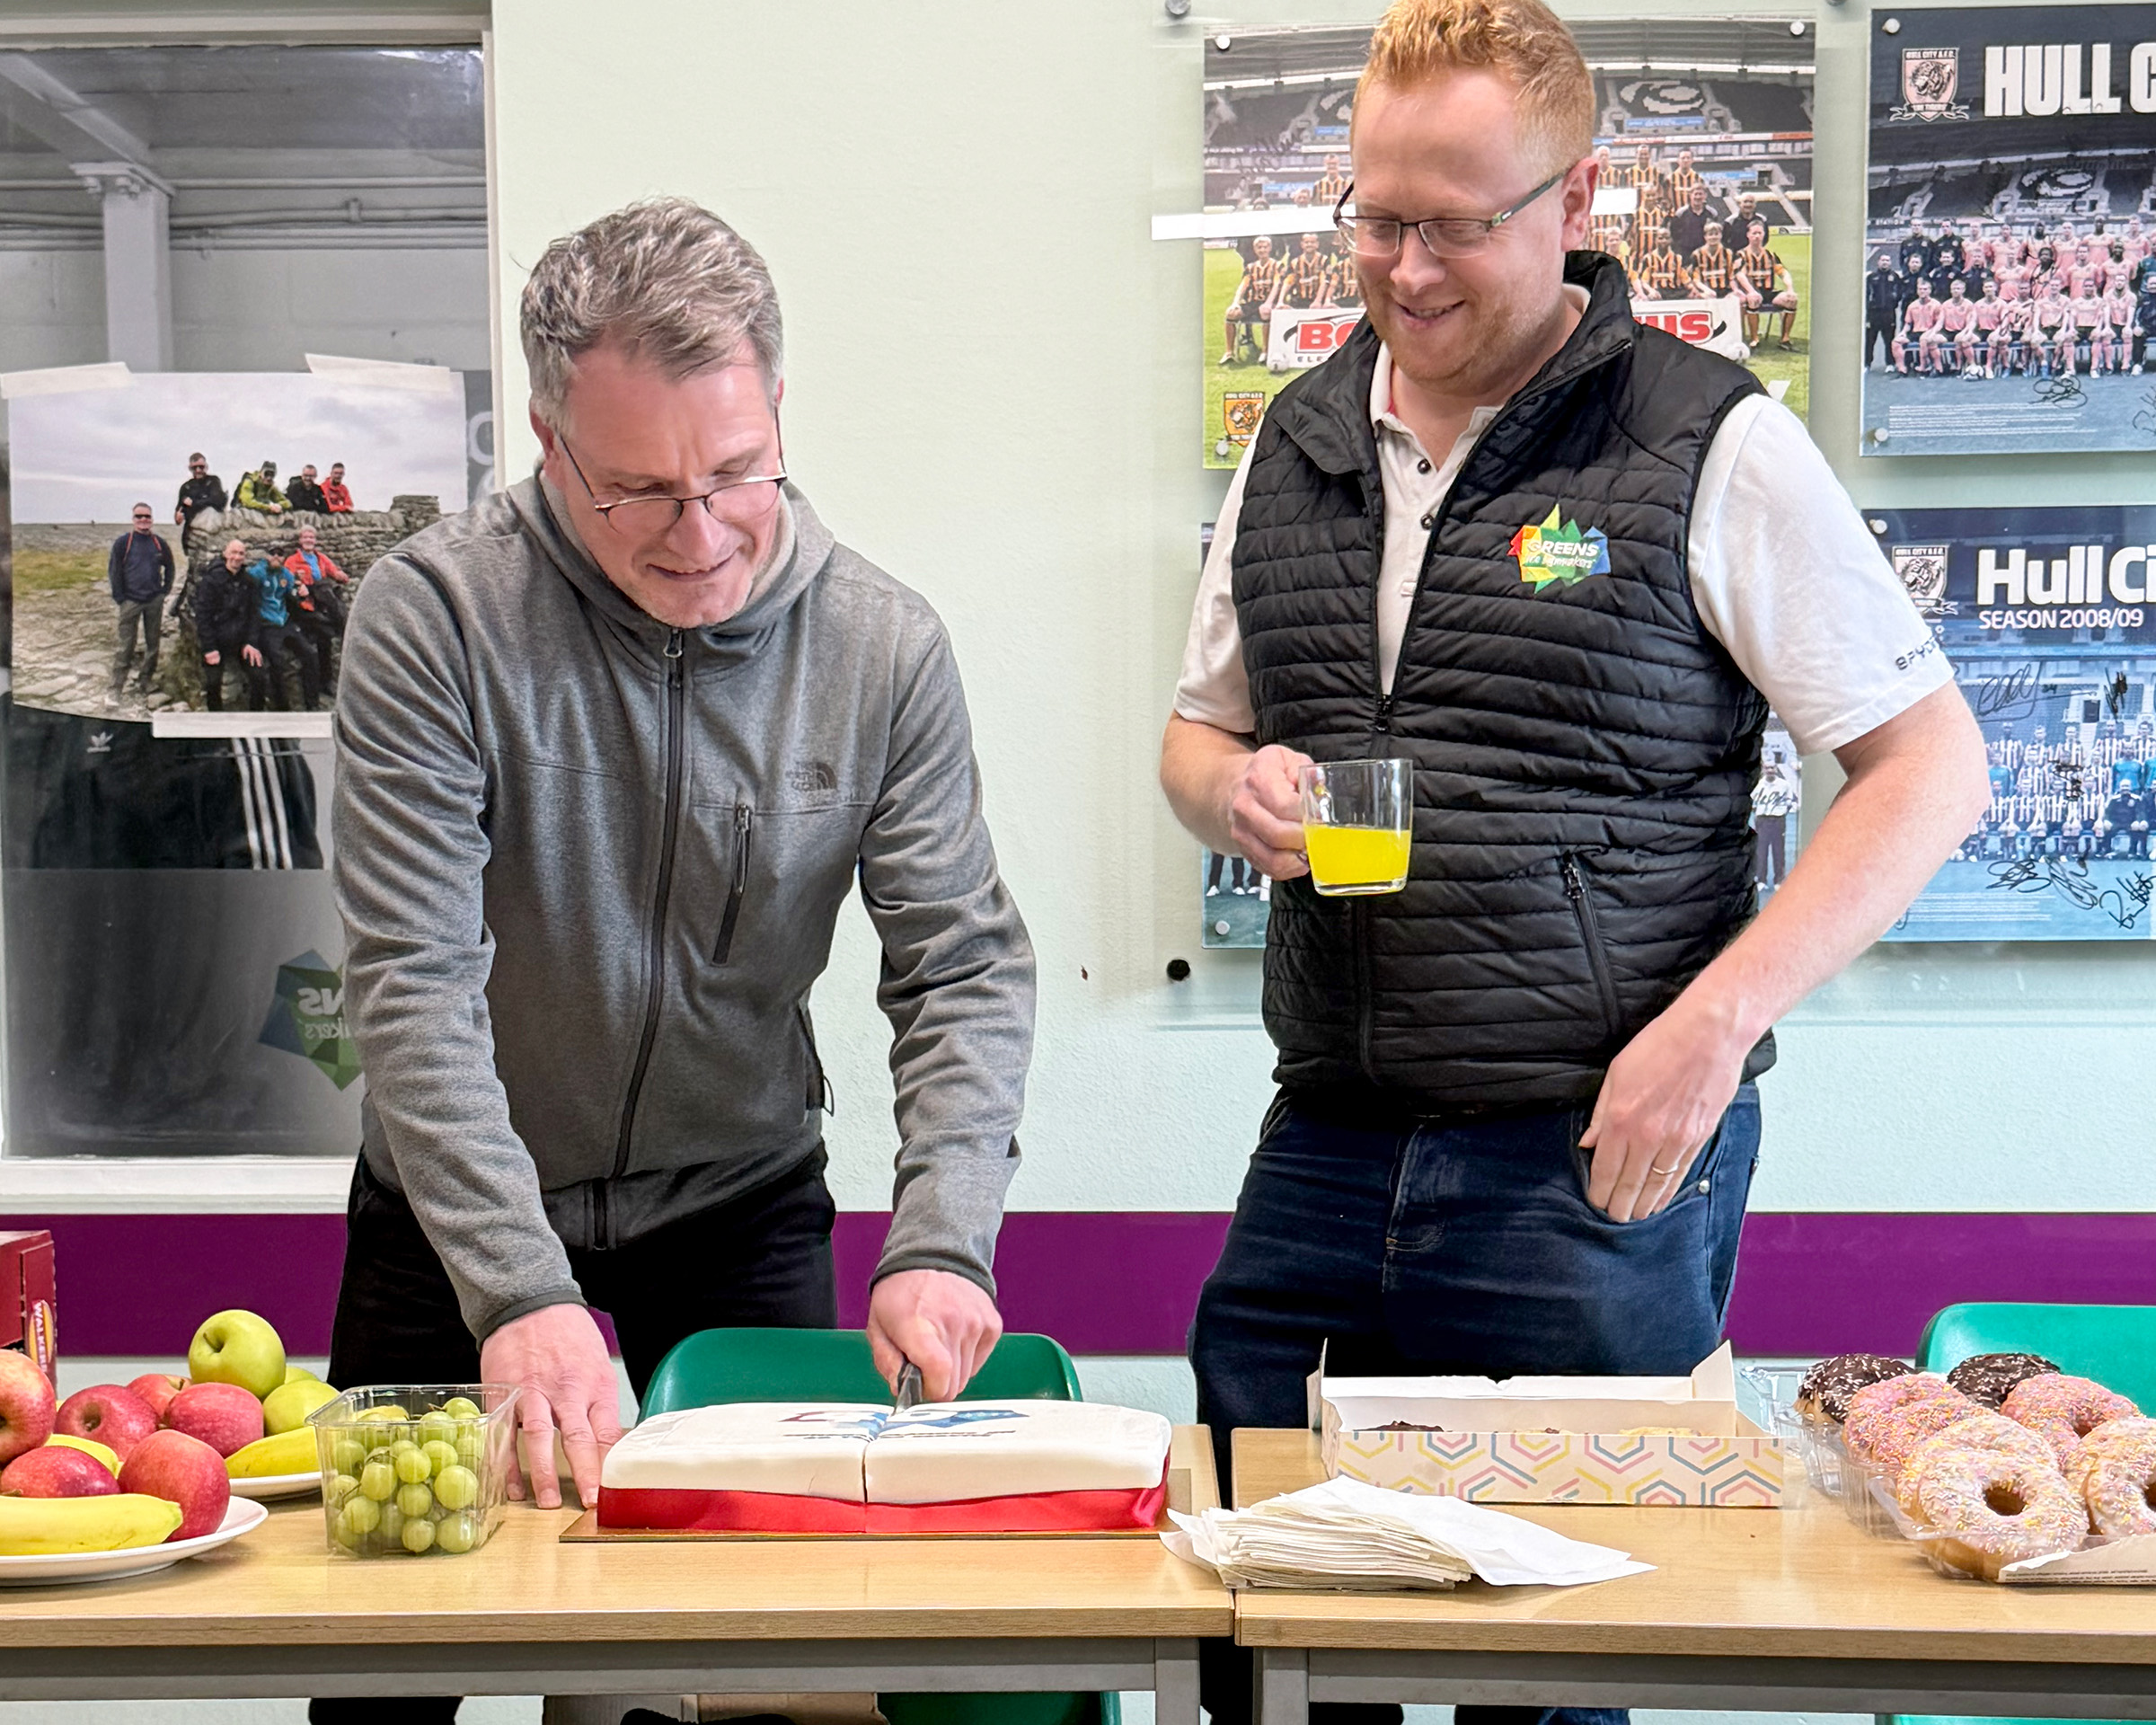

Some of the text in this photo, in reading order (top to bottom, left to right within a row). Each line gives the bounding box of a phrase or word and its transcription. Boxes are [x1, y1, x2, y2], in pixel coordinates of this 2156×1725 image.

[1984, 43, 2121, 117] HULL
[1528, 541, 1599, 557] GREENS
[1978, 545, 2103, 605] Hull
[1979, 608, 2143, 629] SEASON 2008/09
[33, 1302, 48, 1373] WALKERS
